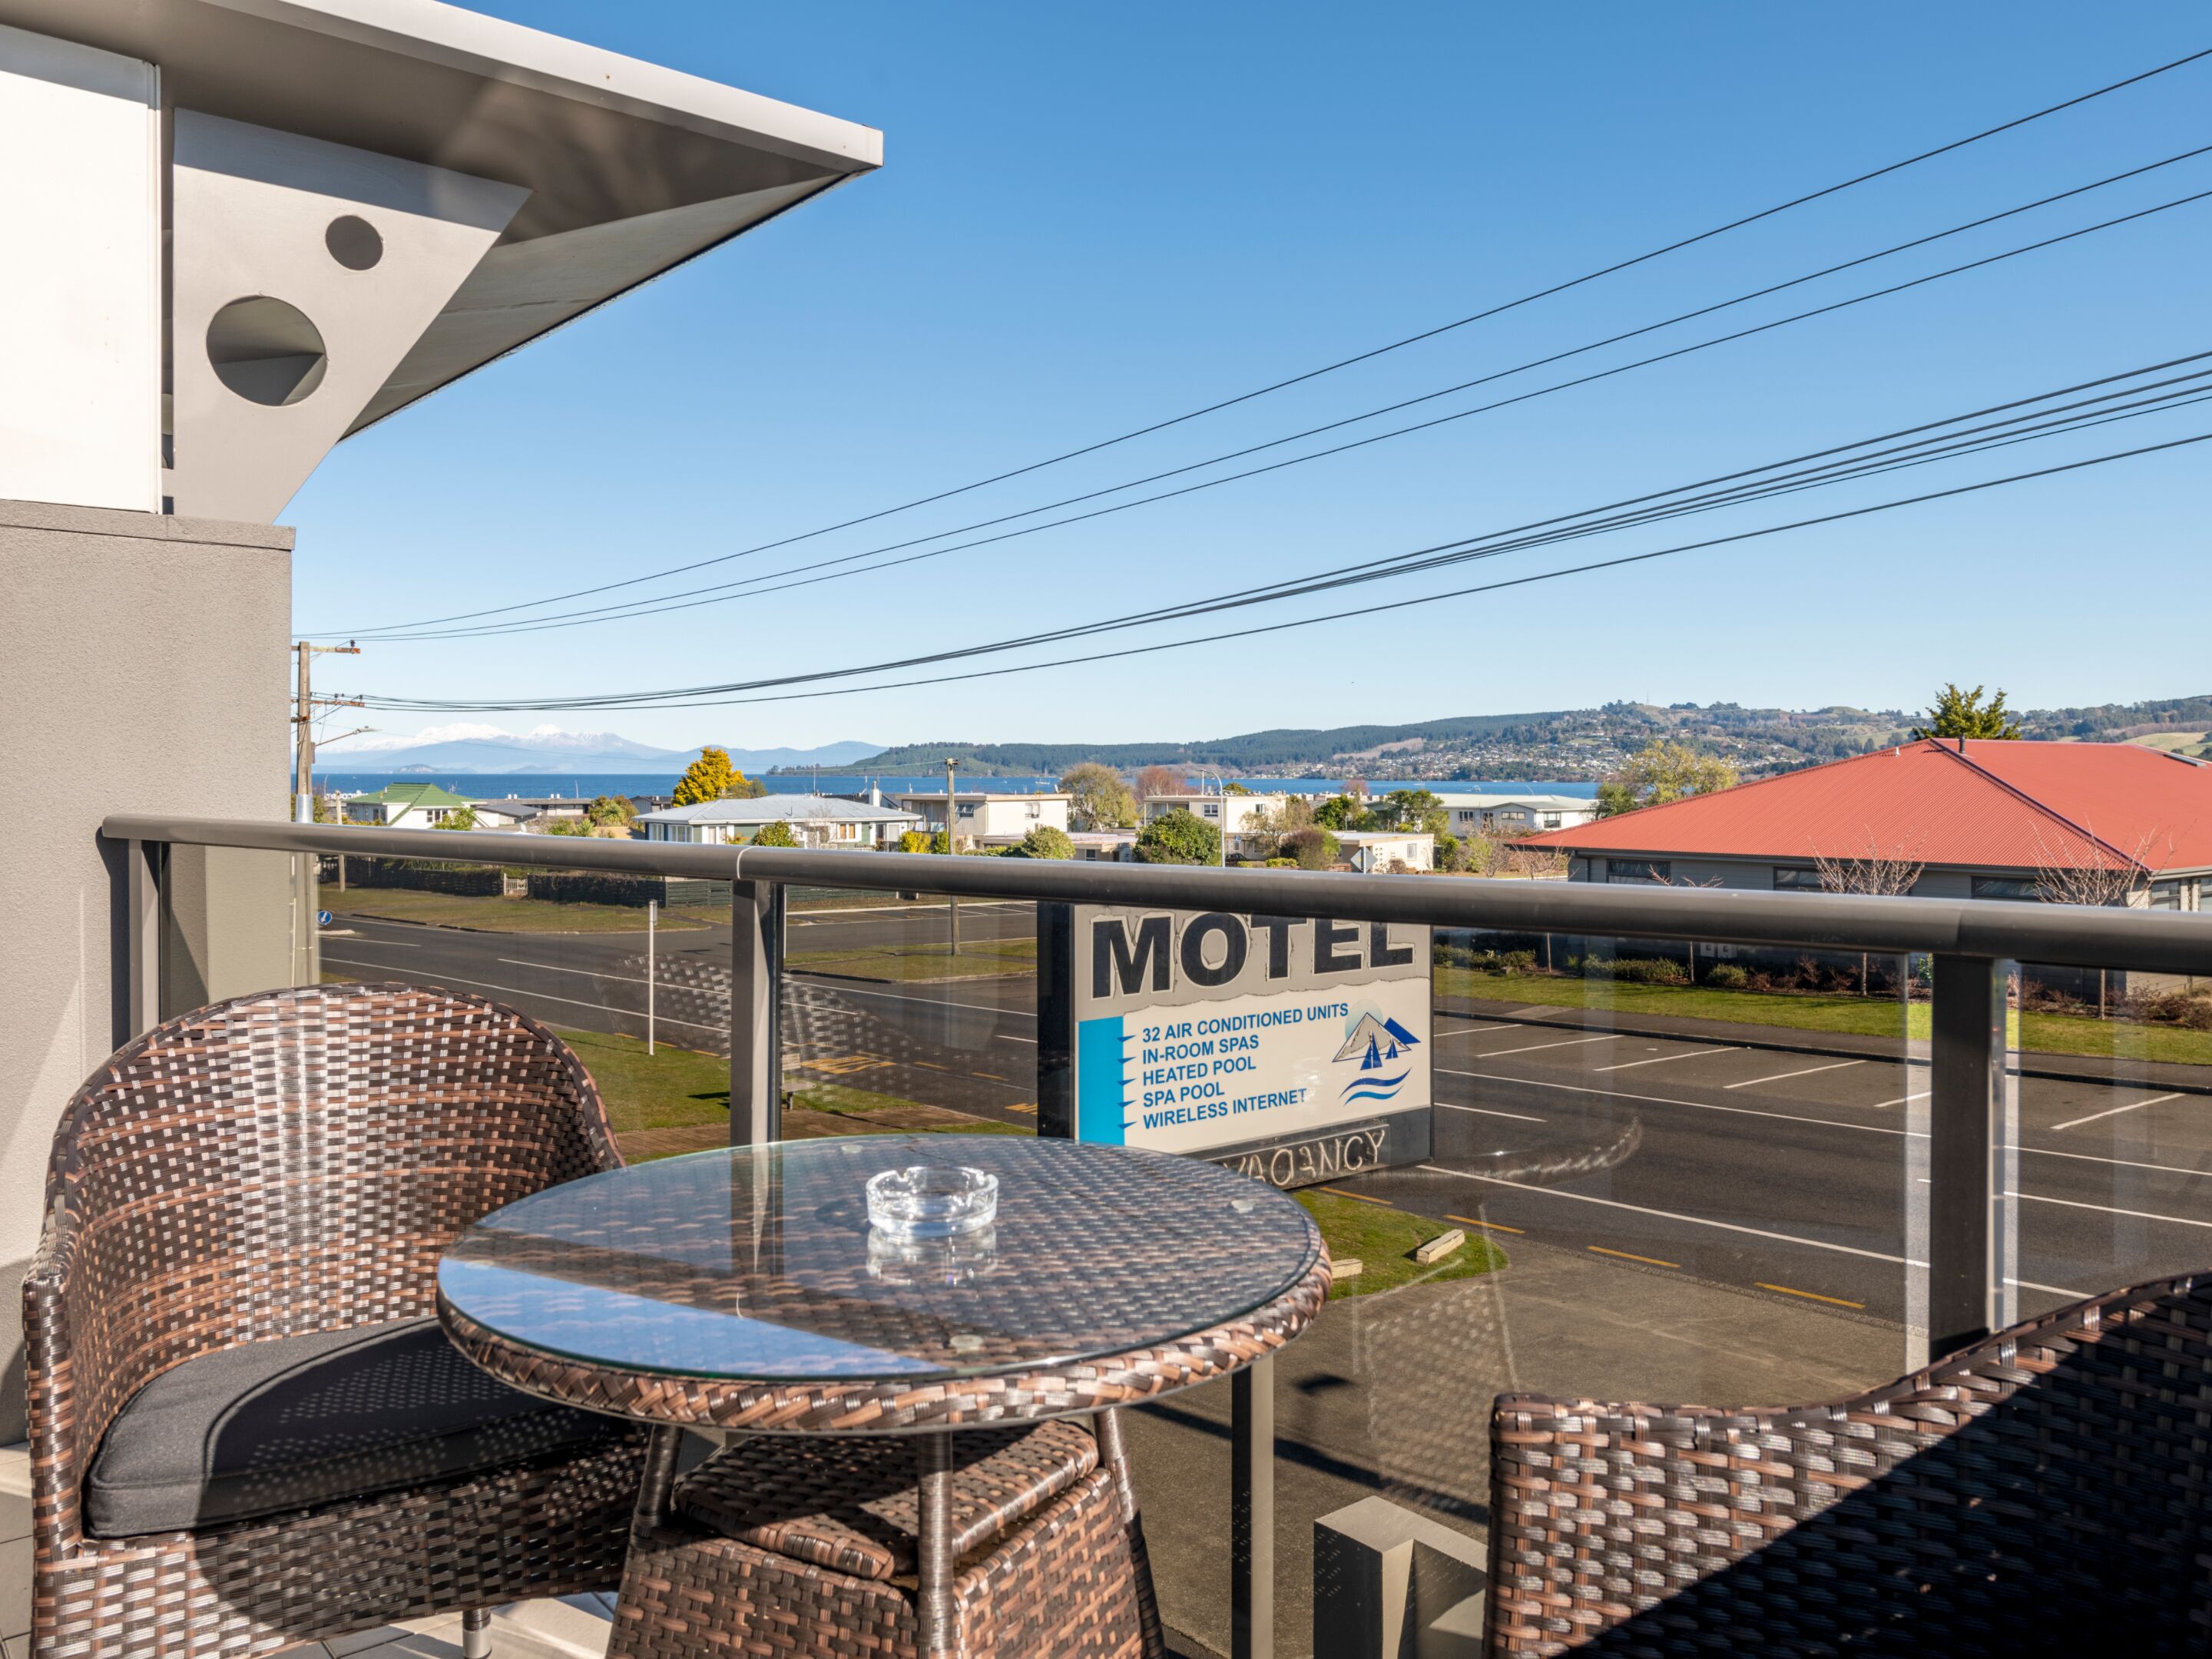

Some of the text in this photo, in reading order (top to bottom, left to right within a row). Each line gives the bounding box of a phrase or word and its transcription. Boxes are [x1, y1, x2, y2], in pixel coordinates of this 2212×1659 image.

[1092, 912, 1414, 998] MOTEL
[1142, 1002, 1349, 1043] 32 AIR CONDITIONED UNITS
[1142, 1034, 1260, 1064] IN-ROOM SPAS
[1142, 1056, 1257, 1086] HEATED POOL
[1143, 1081, 1225, 1108] SPA POOL
[1143, 1088, 1307, 1130] WIRELESS INTERNET
